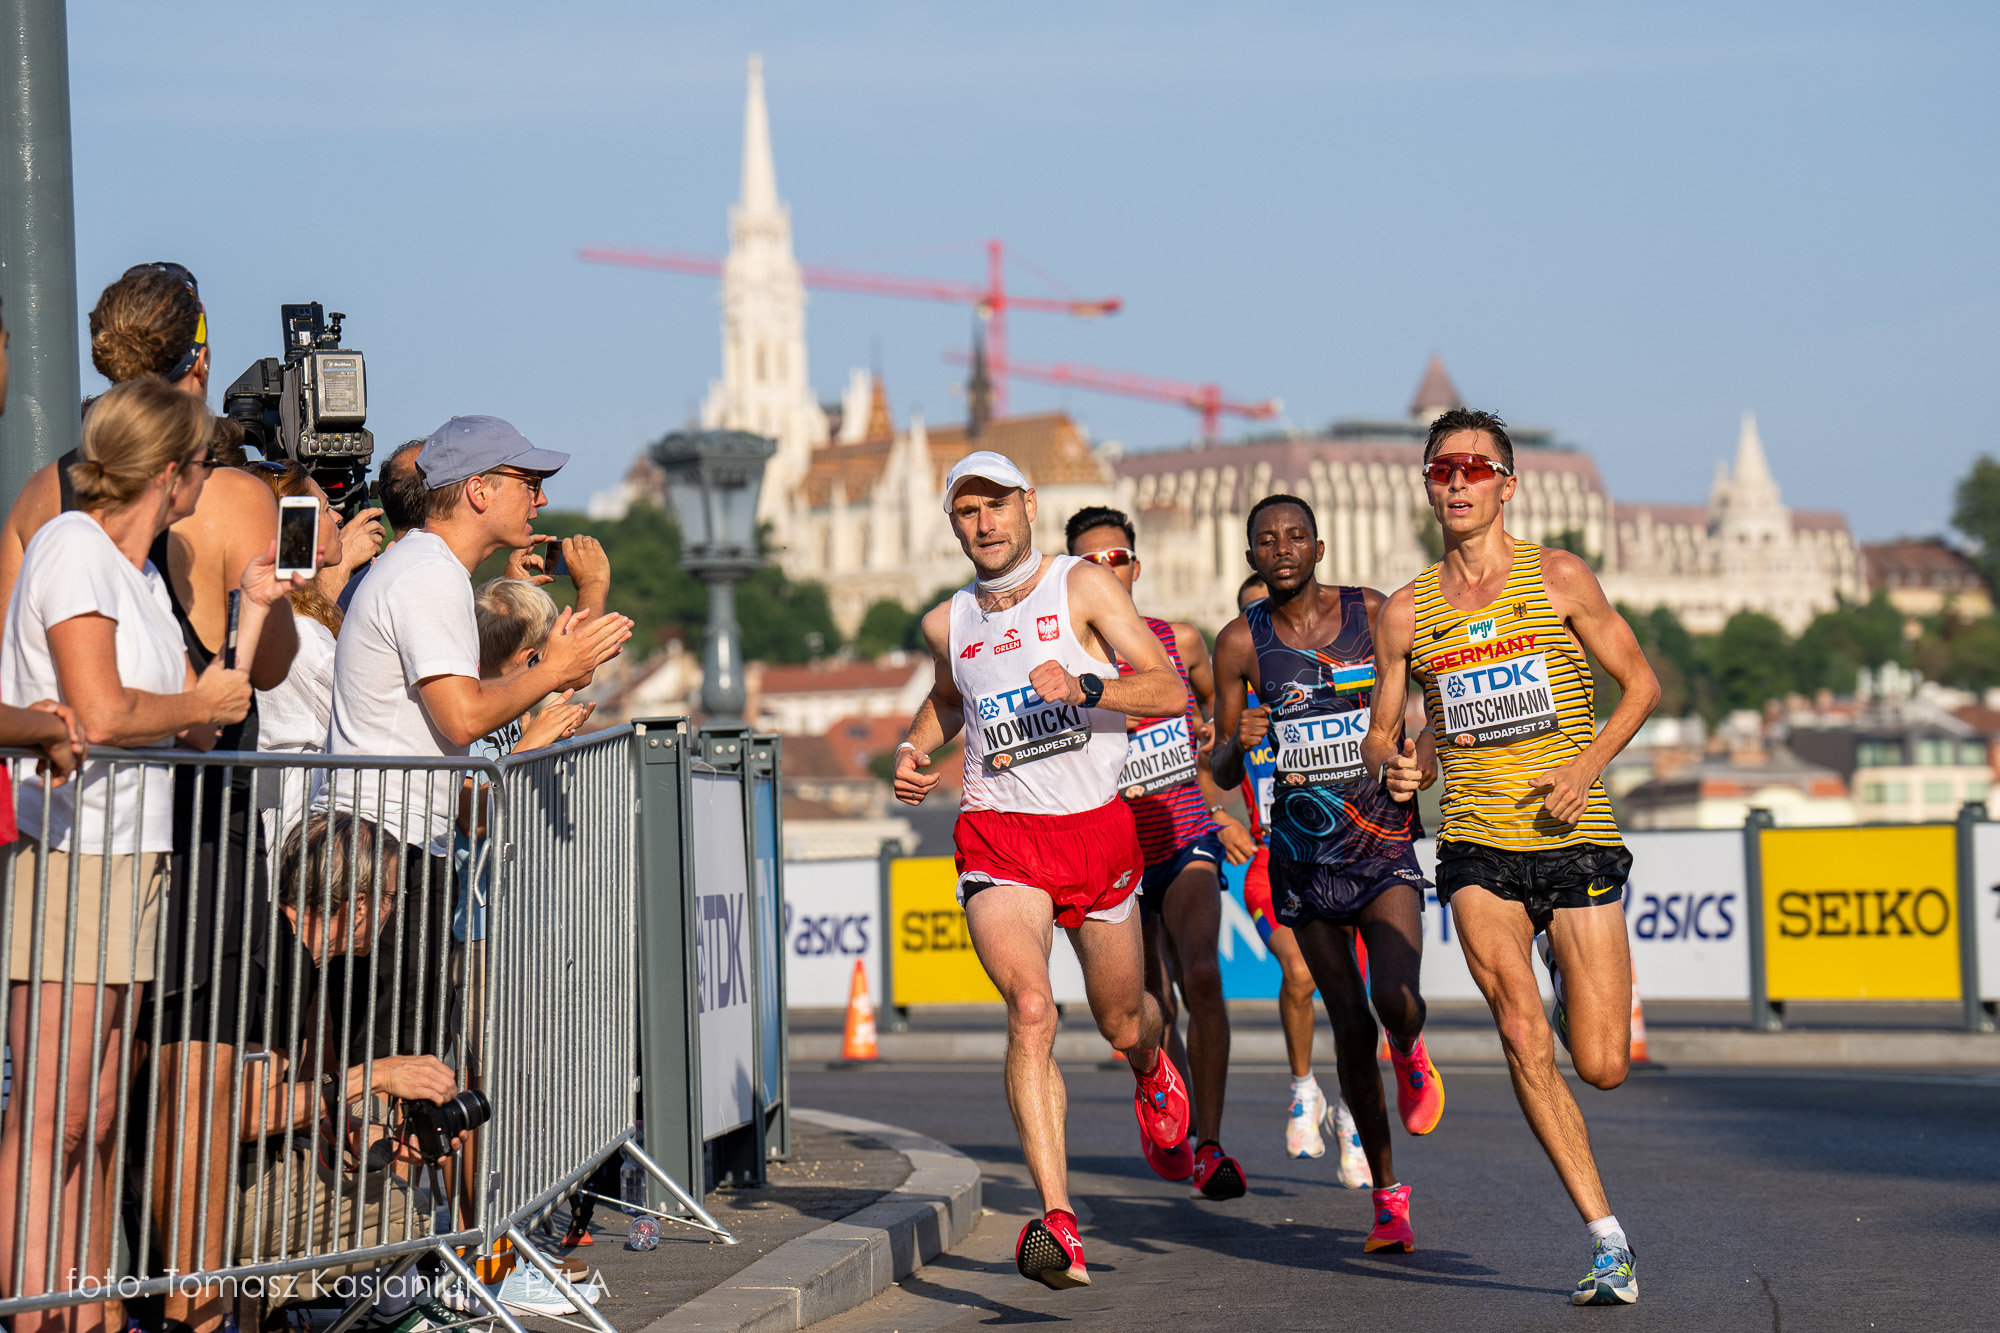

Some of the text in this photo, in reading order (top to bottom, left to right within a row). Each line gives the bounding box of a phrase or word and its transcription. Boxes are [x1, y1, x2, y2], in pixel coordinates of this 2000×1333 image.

[994, 640, 1020, 654] ORLEN
[1430, 633, 1538, 673] GERMANY
[1463, 660, 1539, 693] TDK
[996, 685, 1045, 714] TD
[1278, 703, 1309, 716] UniRun
[1447, 687, 1551, 730] MOTSCHMANN
[983, 704, 1081, 750] NOWICKI
[1131, 720, 1187, 753] TDK
[1298, 713, 1366, 741] TDK
[1478, 719, 1552, 742] BUDAPEST 23
[1015, 733, 1088, 760] BUDAPEST 23
[1282, 740, 1361, 769] MUHITIR
[1145, 769, 1193, 792] BUDAPEST
[1308, 769, 1362, 783] BUDAPEST
[1635, 892, 1736, 942] asics
[1778, 887, 1950, 938] SEIKO
[794, 912, 870, 957] asics
[901, 909, 974, 953] SEI
[703, 892, 747, 1011] TDK
